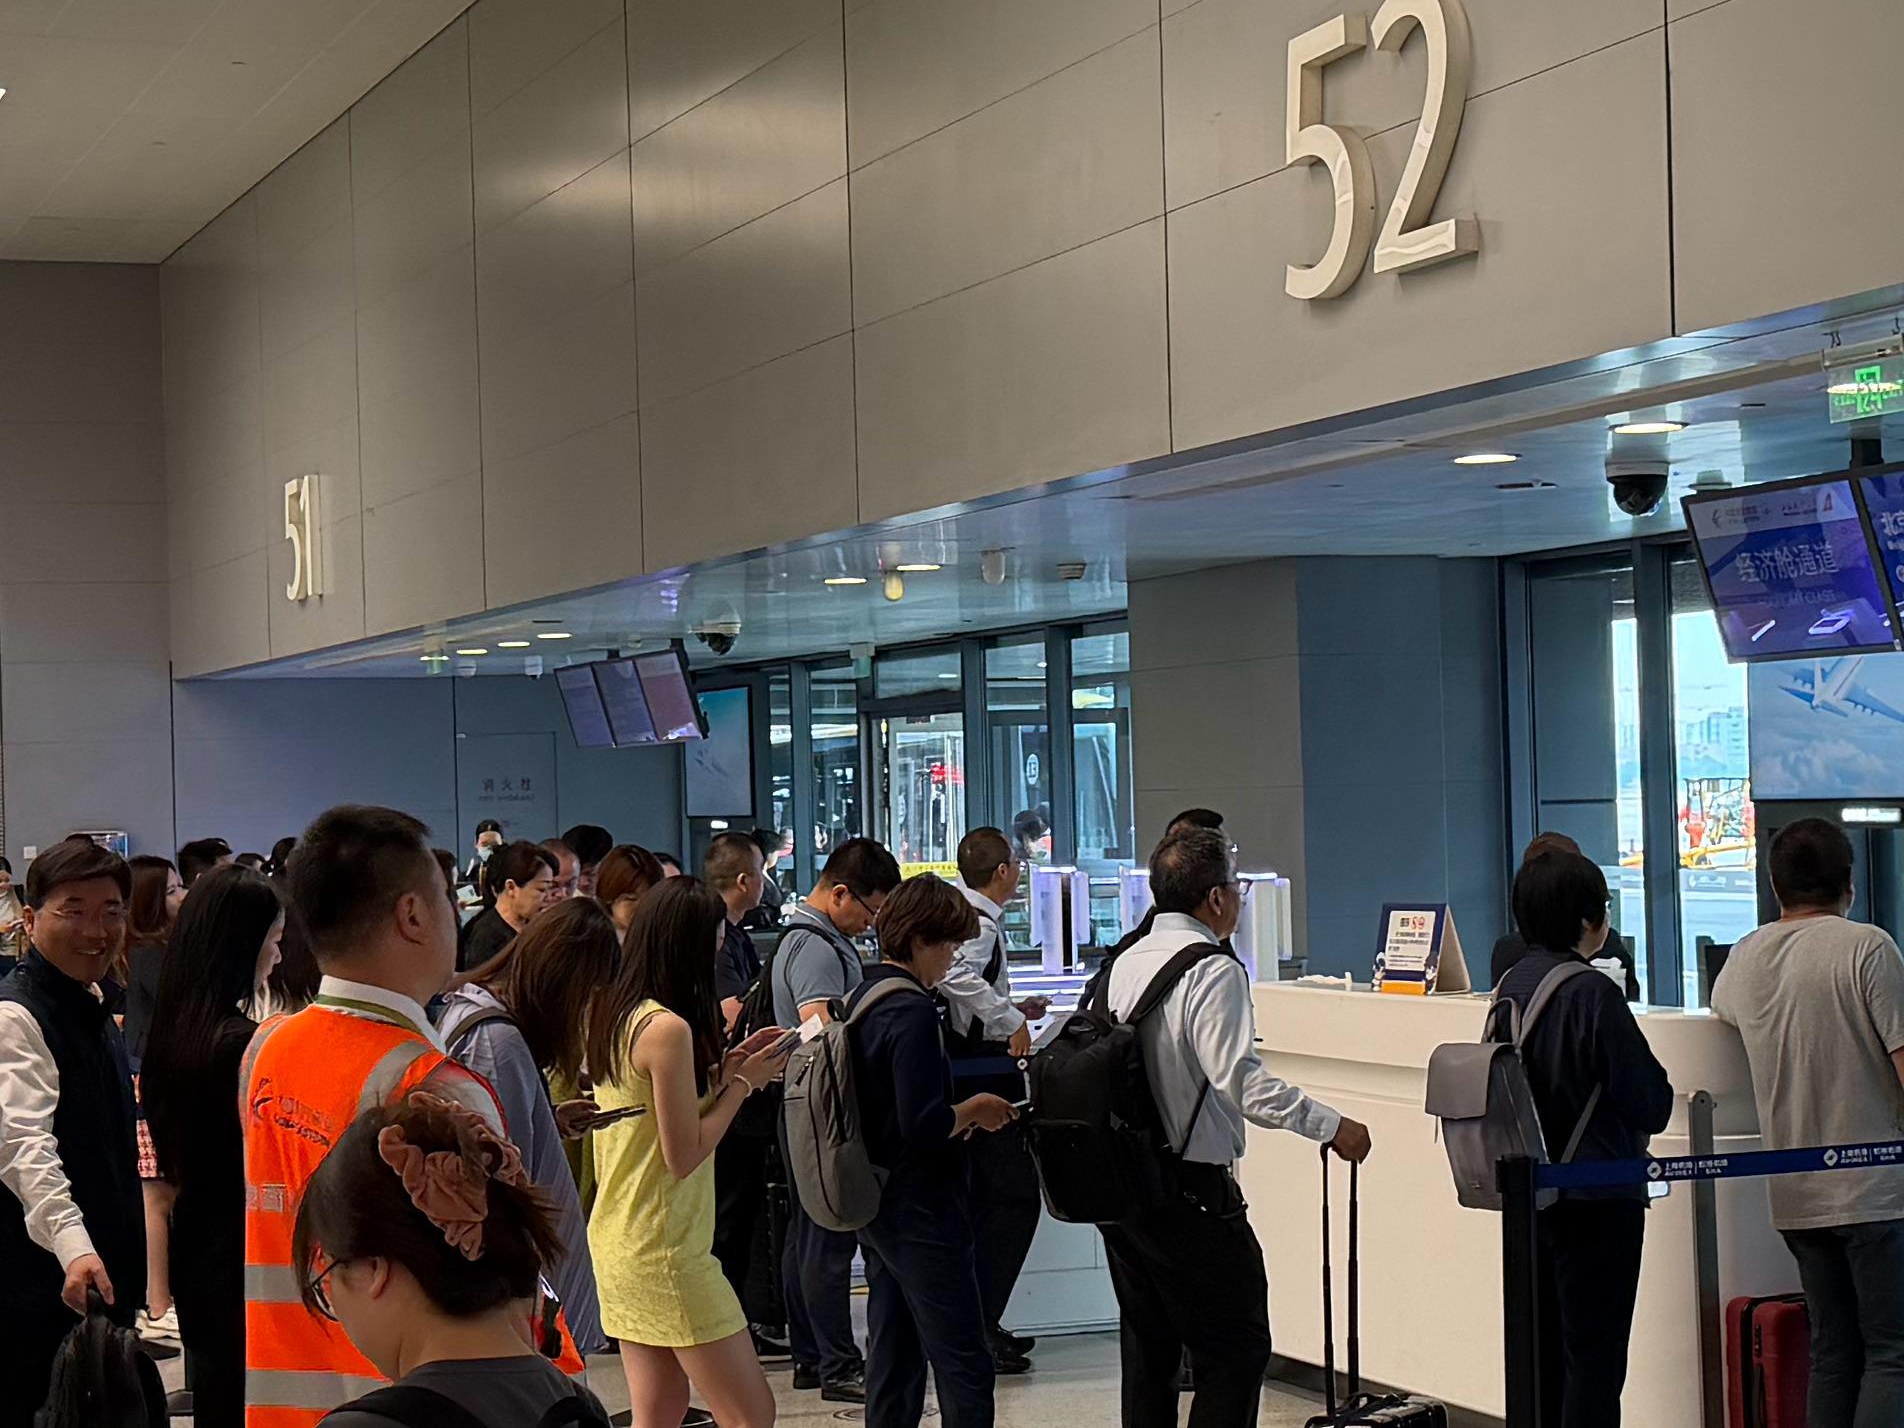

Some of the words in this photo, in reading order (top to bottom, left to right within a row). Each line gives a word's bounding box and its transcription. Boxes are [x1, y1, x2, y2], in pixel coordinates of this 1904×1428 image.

[285, 474, 322, 601] 51
[1735, 540, 1840, 583] 经济舱通道
